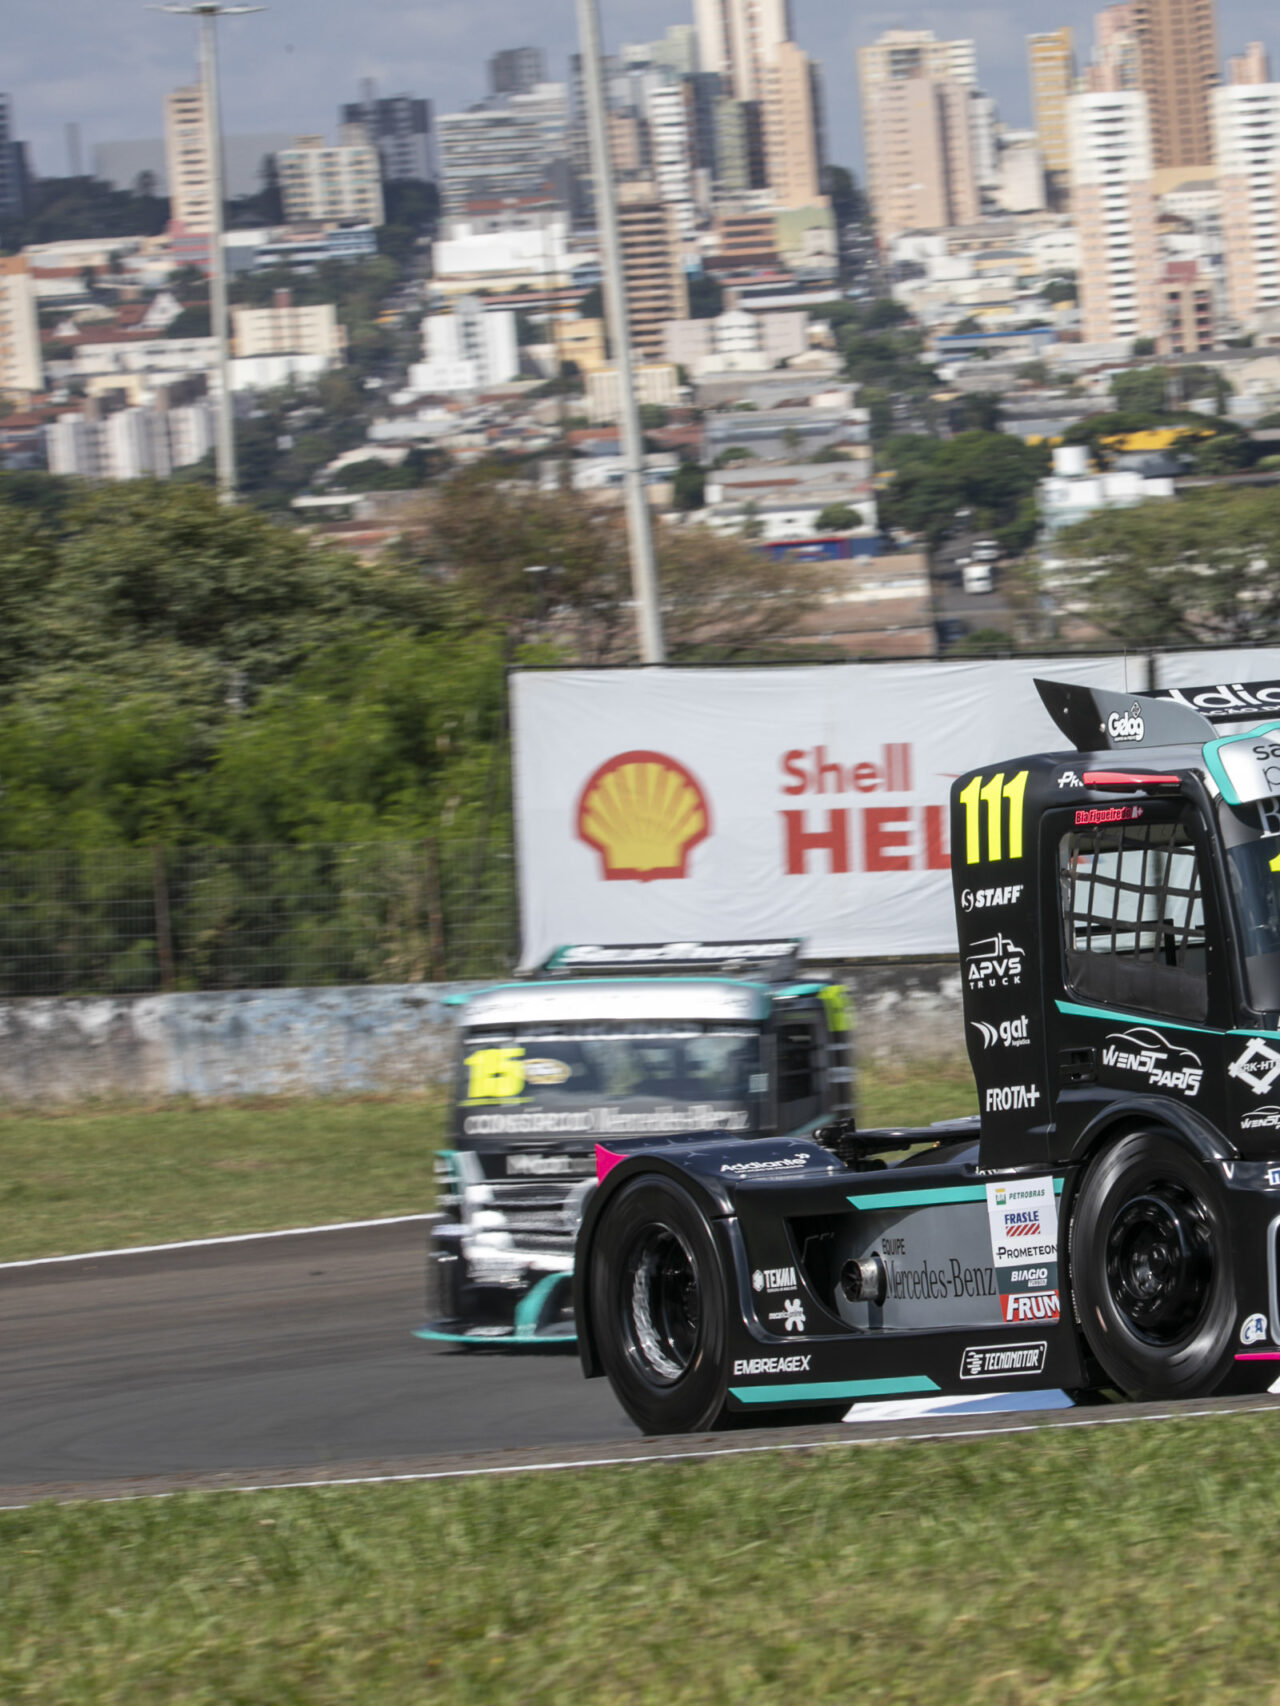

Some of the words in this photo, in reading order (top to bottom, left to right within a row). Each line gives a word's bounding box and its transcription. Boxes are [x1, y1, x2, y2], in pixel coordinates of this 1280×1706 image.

[1108, 711, 1144, 741] Gelog
[779, 741, 913, 796] Shell
[959, 770, 1029, 865] 111
[975, 885, 1023, 908] STAFF
[968, 957, 1022, 980] APVS
[969, 975, 1022, 990] TRUCK
[1102, 1044, 1168, 1074] WENDT
[1148, 1067, 1204, 1096] PARTS
[1008, 1189, 1045, 1200] PETROBRAS
[881, 1238, 906, 1256] EQUIPE
[883, 1257, 997, 1300] Mercedes-Benz
[1011, 1267, 1048, 1283] BIAGIO
[733, 1354, 812, 1376] EMBREAGEX
[984, 1348, 1041, 1371] TECNOMOTOR
